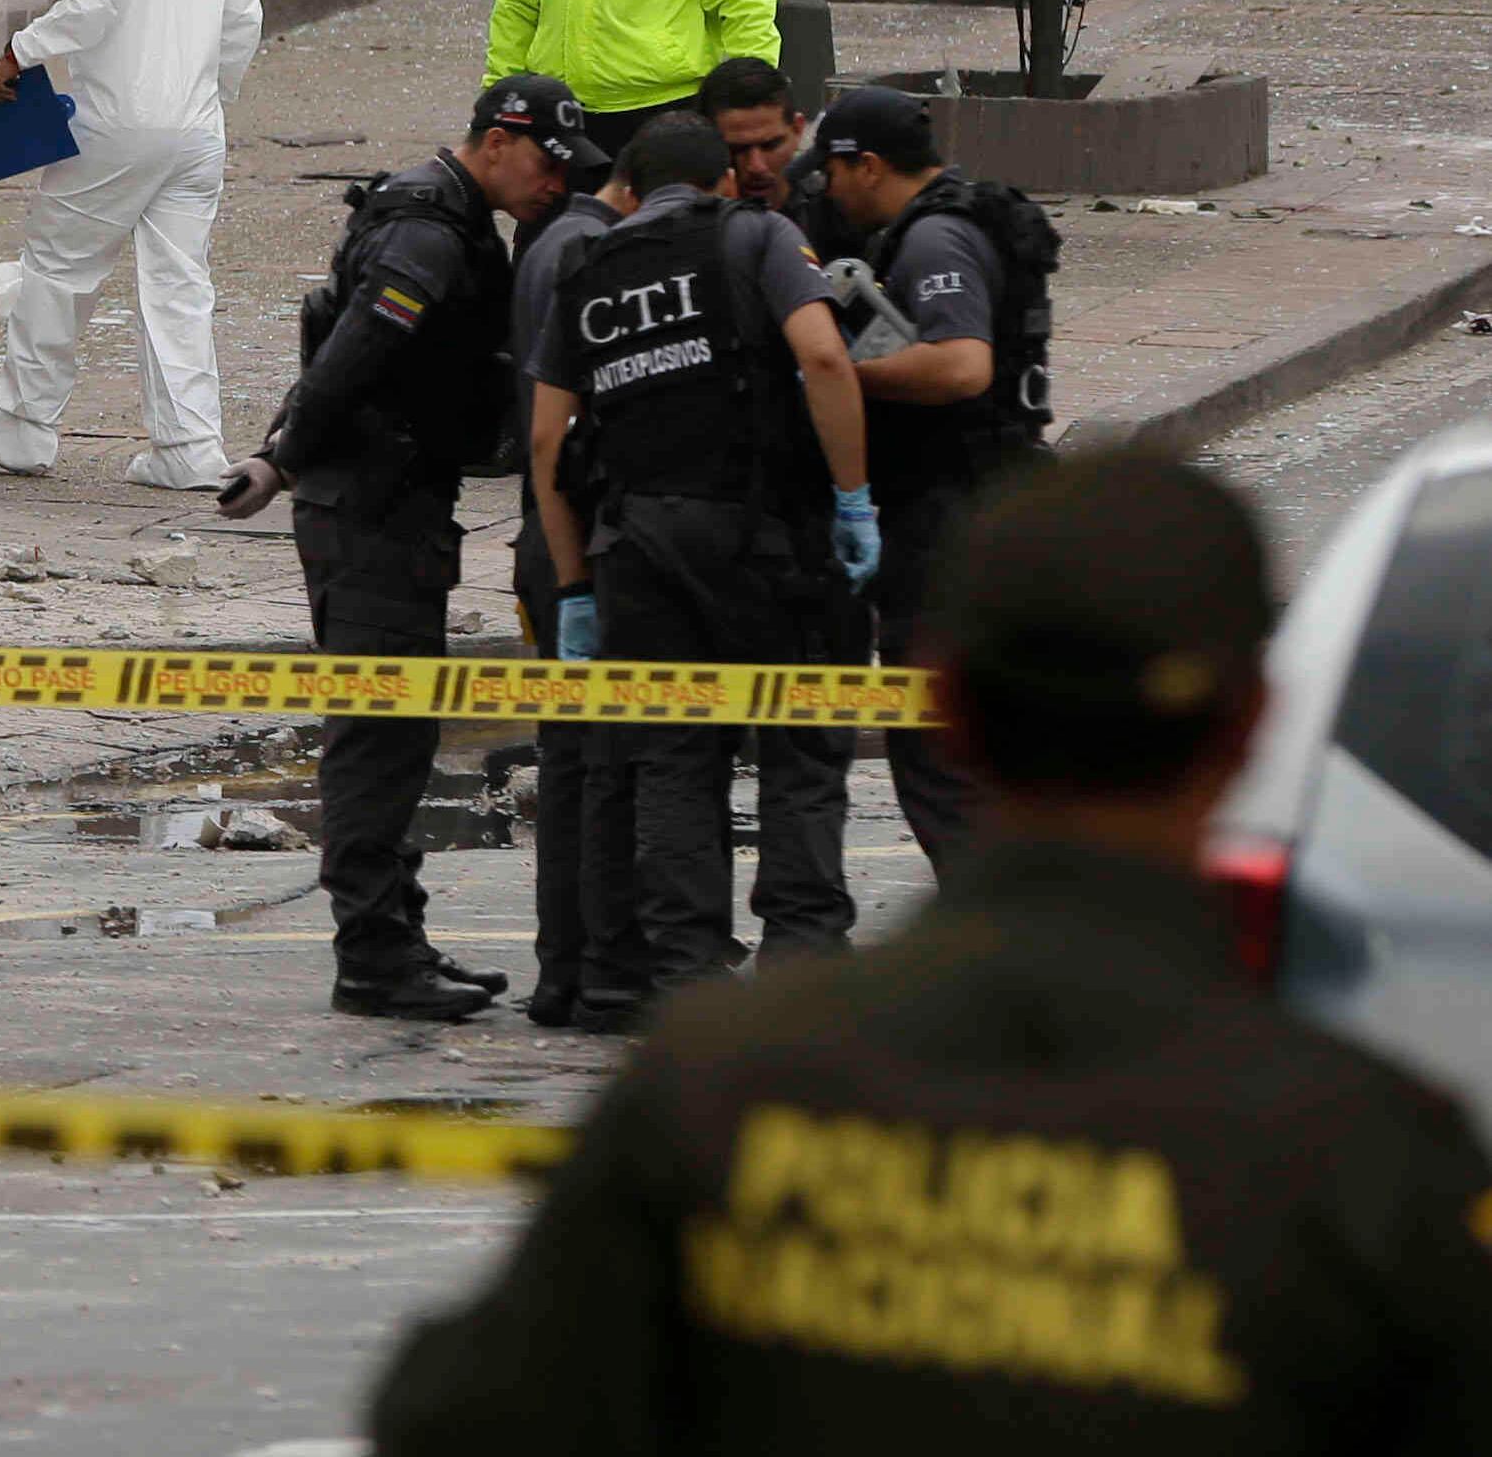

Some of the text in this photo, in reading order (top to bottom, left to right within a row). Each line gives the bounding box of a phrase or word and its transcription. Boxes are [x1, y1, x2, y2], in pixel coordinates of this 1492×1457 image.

[593, 337, 713, 394] ANTIEXPLOSIVOS
[30, 667, 97, 691] PASE
[156, 670, 411, 699] PELIGRO NO PASE
